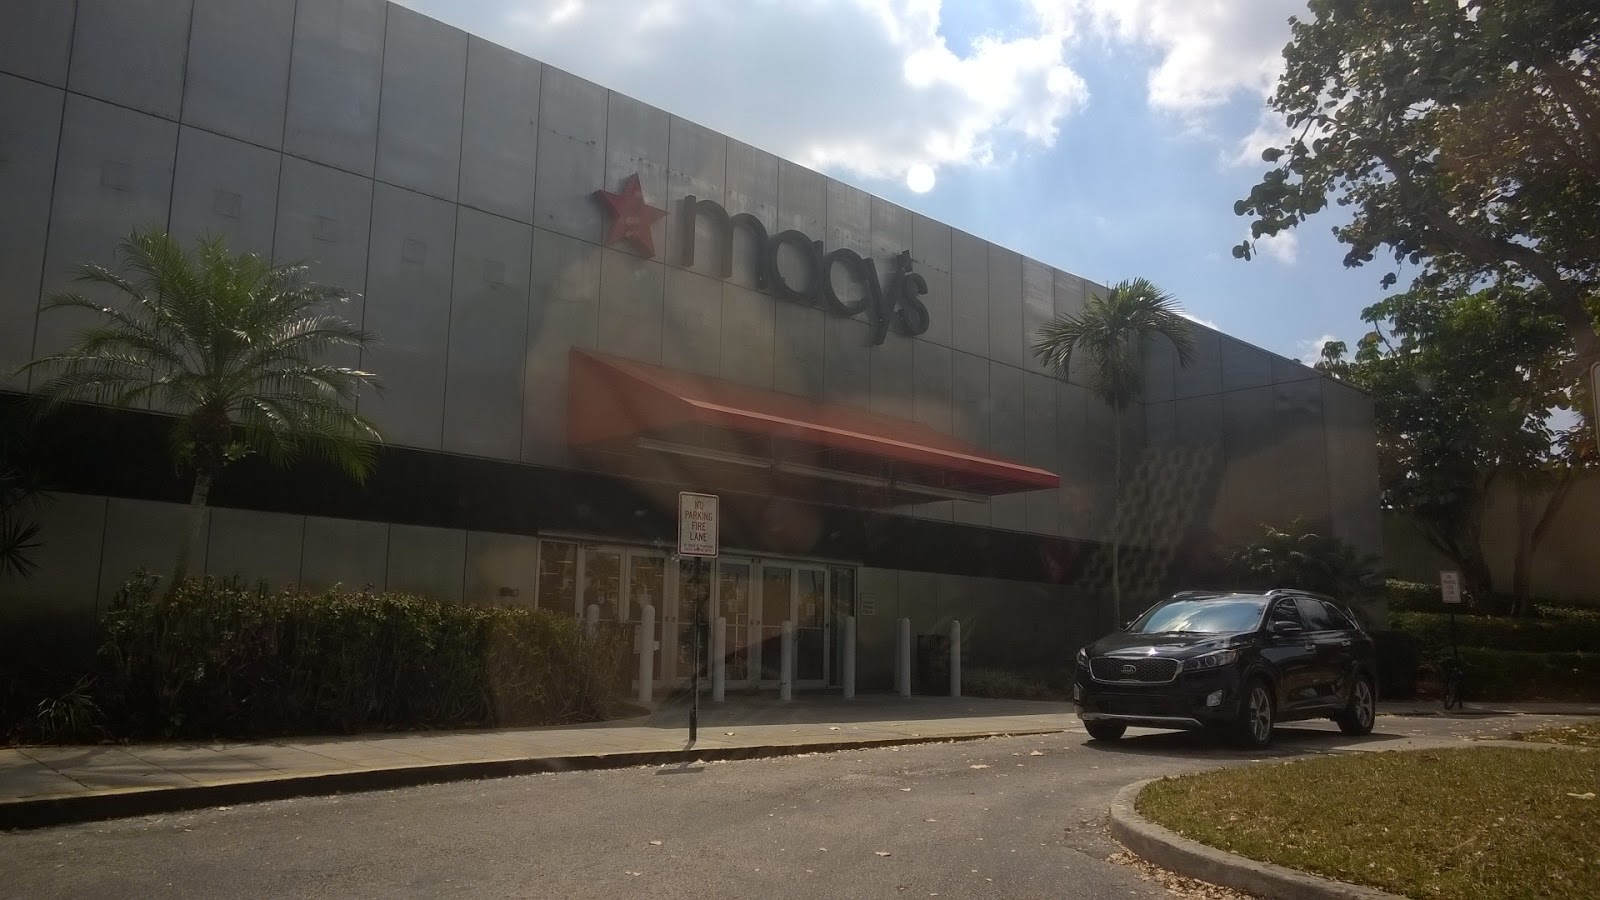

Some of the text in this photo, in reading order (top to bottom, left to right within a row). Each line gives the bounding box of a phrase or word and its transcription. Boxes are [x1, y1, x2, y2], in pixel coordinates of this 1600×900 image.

[682, 195, 929, 345] macy's
[694, 500, 704, 510] NO
[685, 510, 713, 521] PARKING
[691, 521, 707, 531] FIRE
[689, 532, 708, 542] LANE
